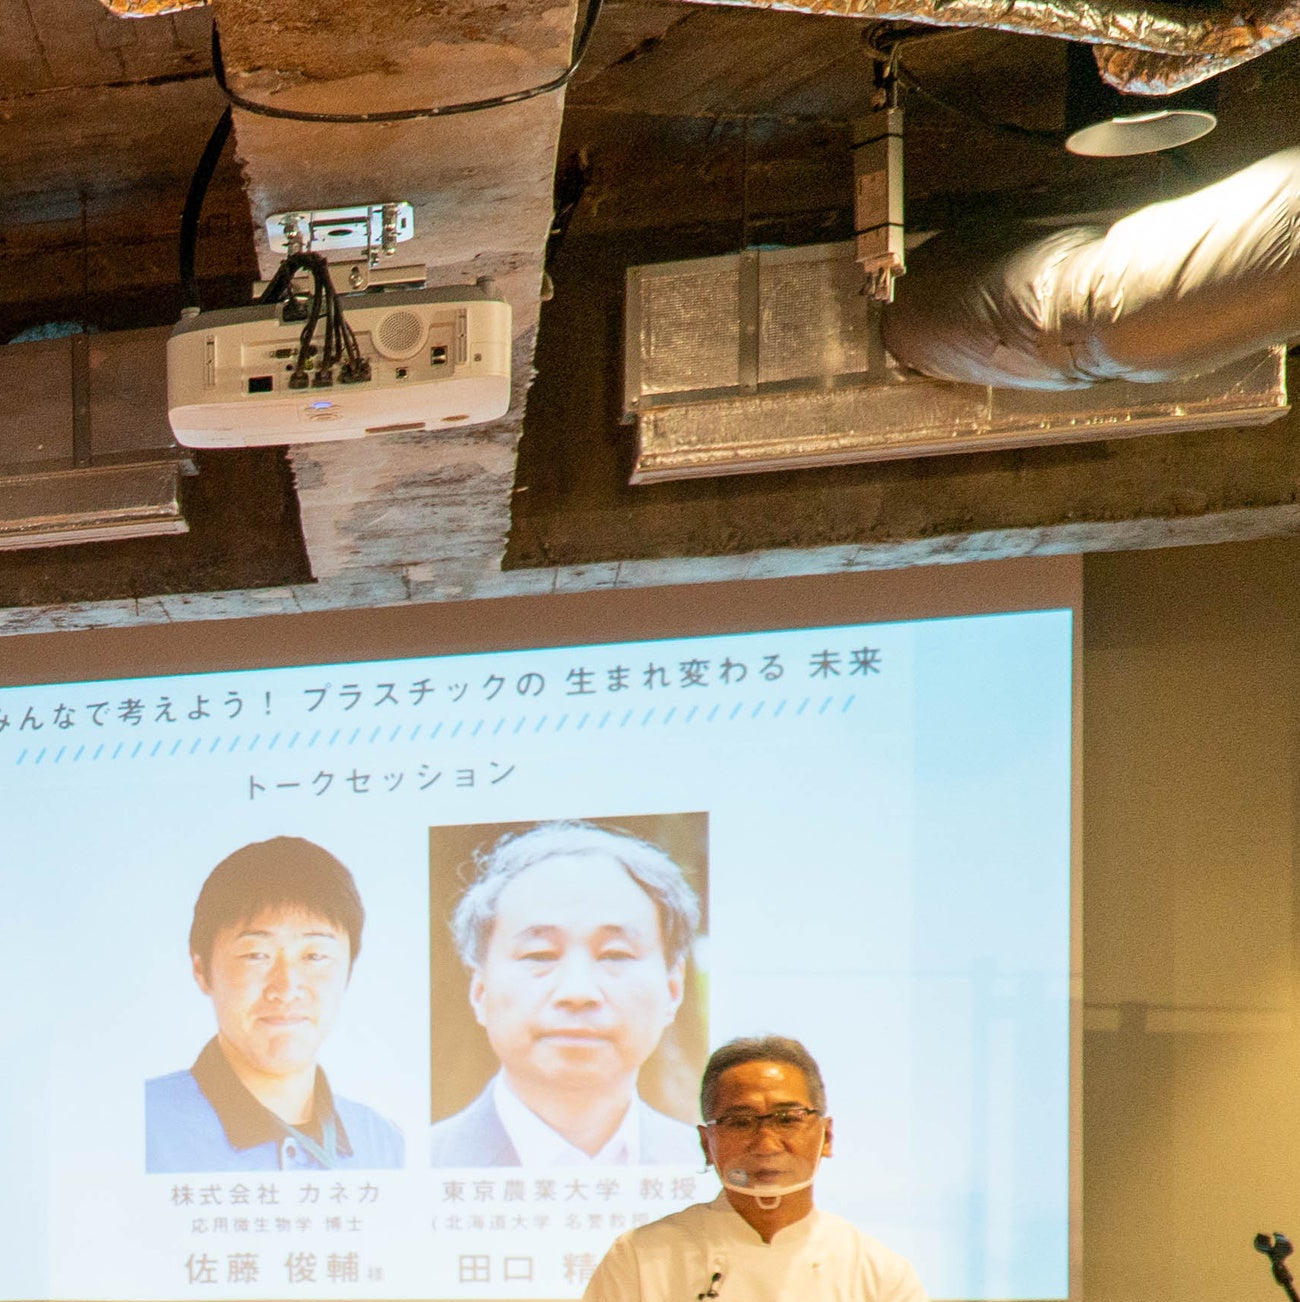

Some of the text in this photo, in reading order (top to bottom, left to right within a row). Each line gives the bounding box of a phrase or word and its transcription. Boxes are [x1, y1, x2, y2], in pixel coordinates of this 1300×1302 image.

[301, 667, 545, 713] プラスチックの
[565, 654, 785, 697] 生まれ変わる
[809, 646, 882, 679] 未来
[249, 761, 516, 801] トークセッション
[170, 1181, 379, 1206] 株式会社 カネカ
[442, 1176, 697, 1203] 東京農業大学 教授
[191, 1216, 361, 1234] 応用微生物学 博士
[184, 1252, 259, 1285] 佐藤
[458, 1254, 534, 1284] 田口
